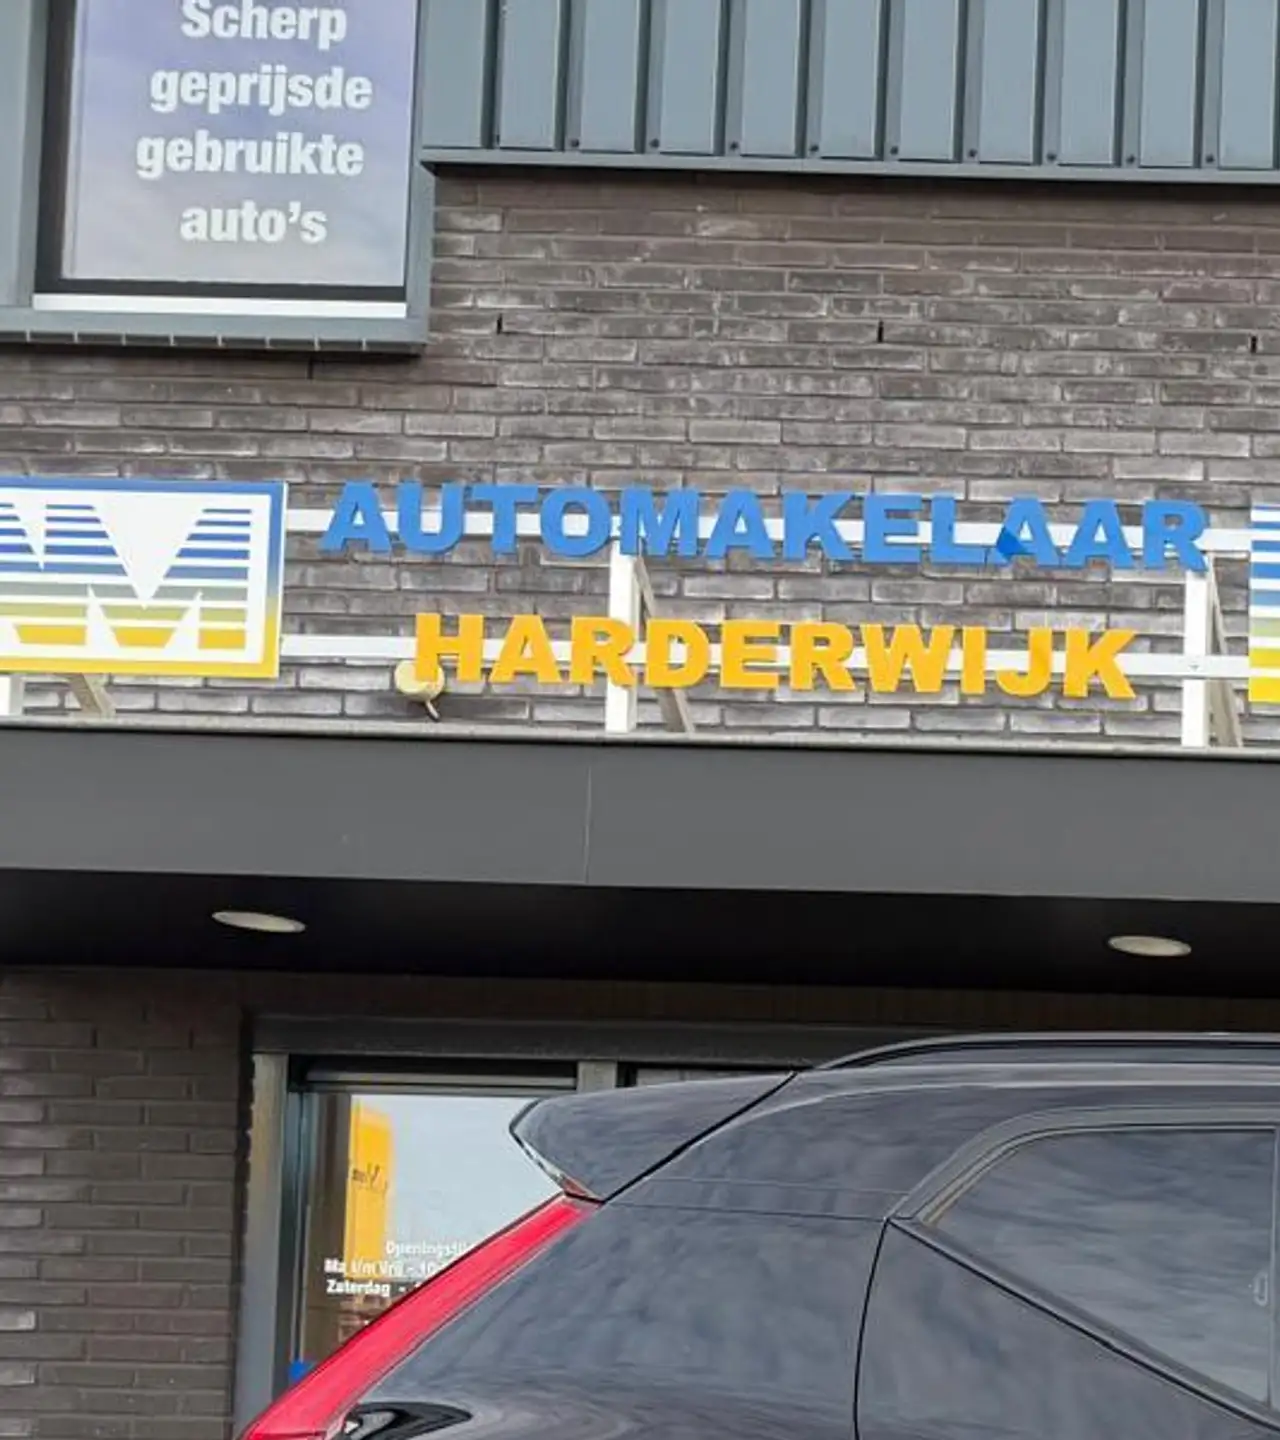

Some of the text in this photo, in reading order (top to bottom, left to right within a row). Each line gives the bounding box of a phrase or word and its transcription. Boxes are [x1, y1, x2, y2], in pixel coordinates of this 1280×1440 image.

[180, 0, 347, 50] Scherp
[150, 64, 373, 116] geprijsde
[136, 130, 364, 180] gebruikte
[179, 200, 328, 244] auto's
[323, 479, 1209, 572] AUTOMAKELAAR
[413, 612, 1137, 700] HARDERWIJK
